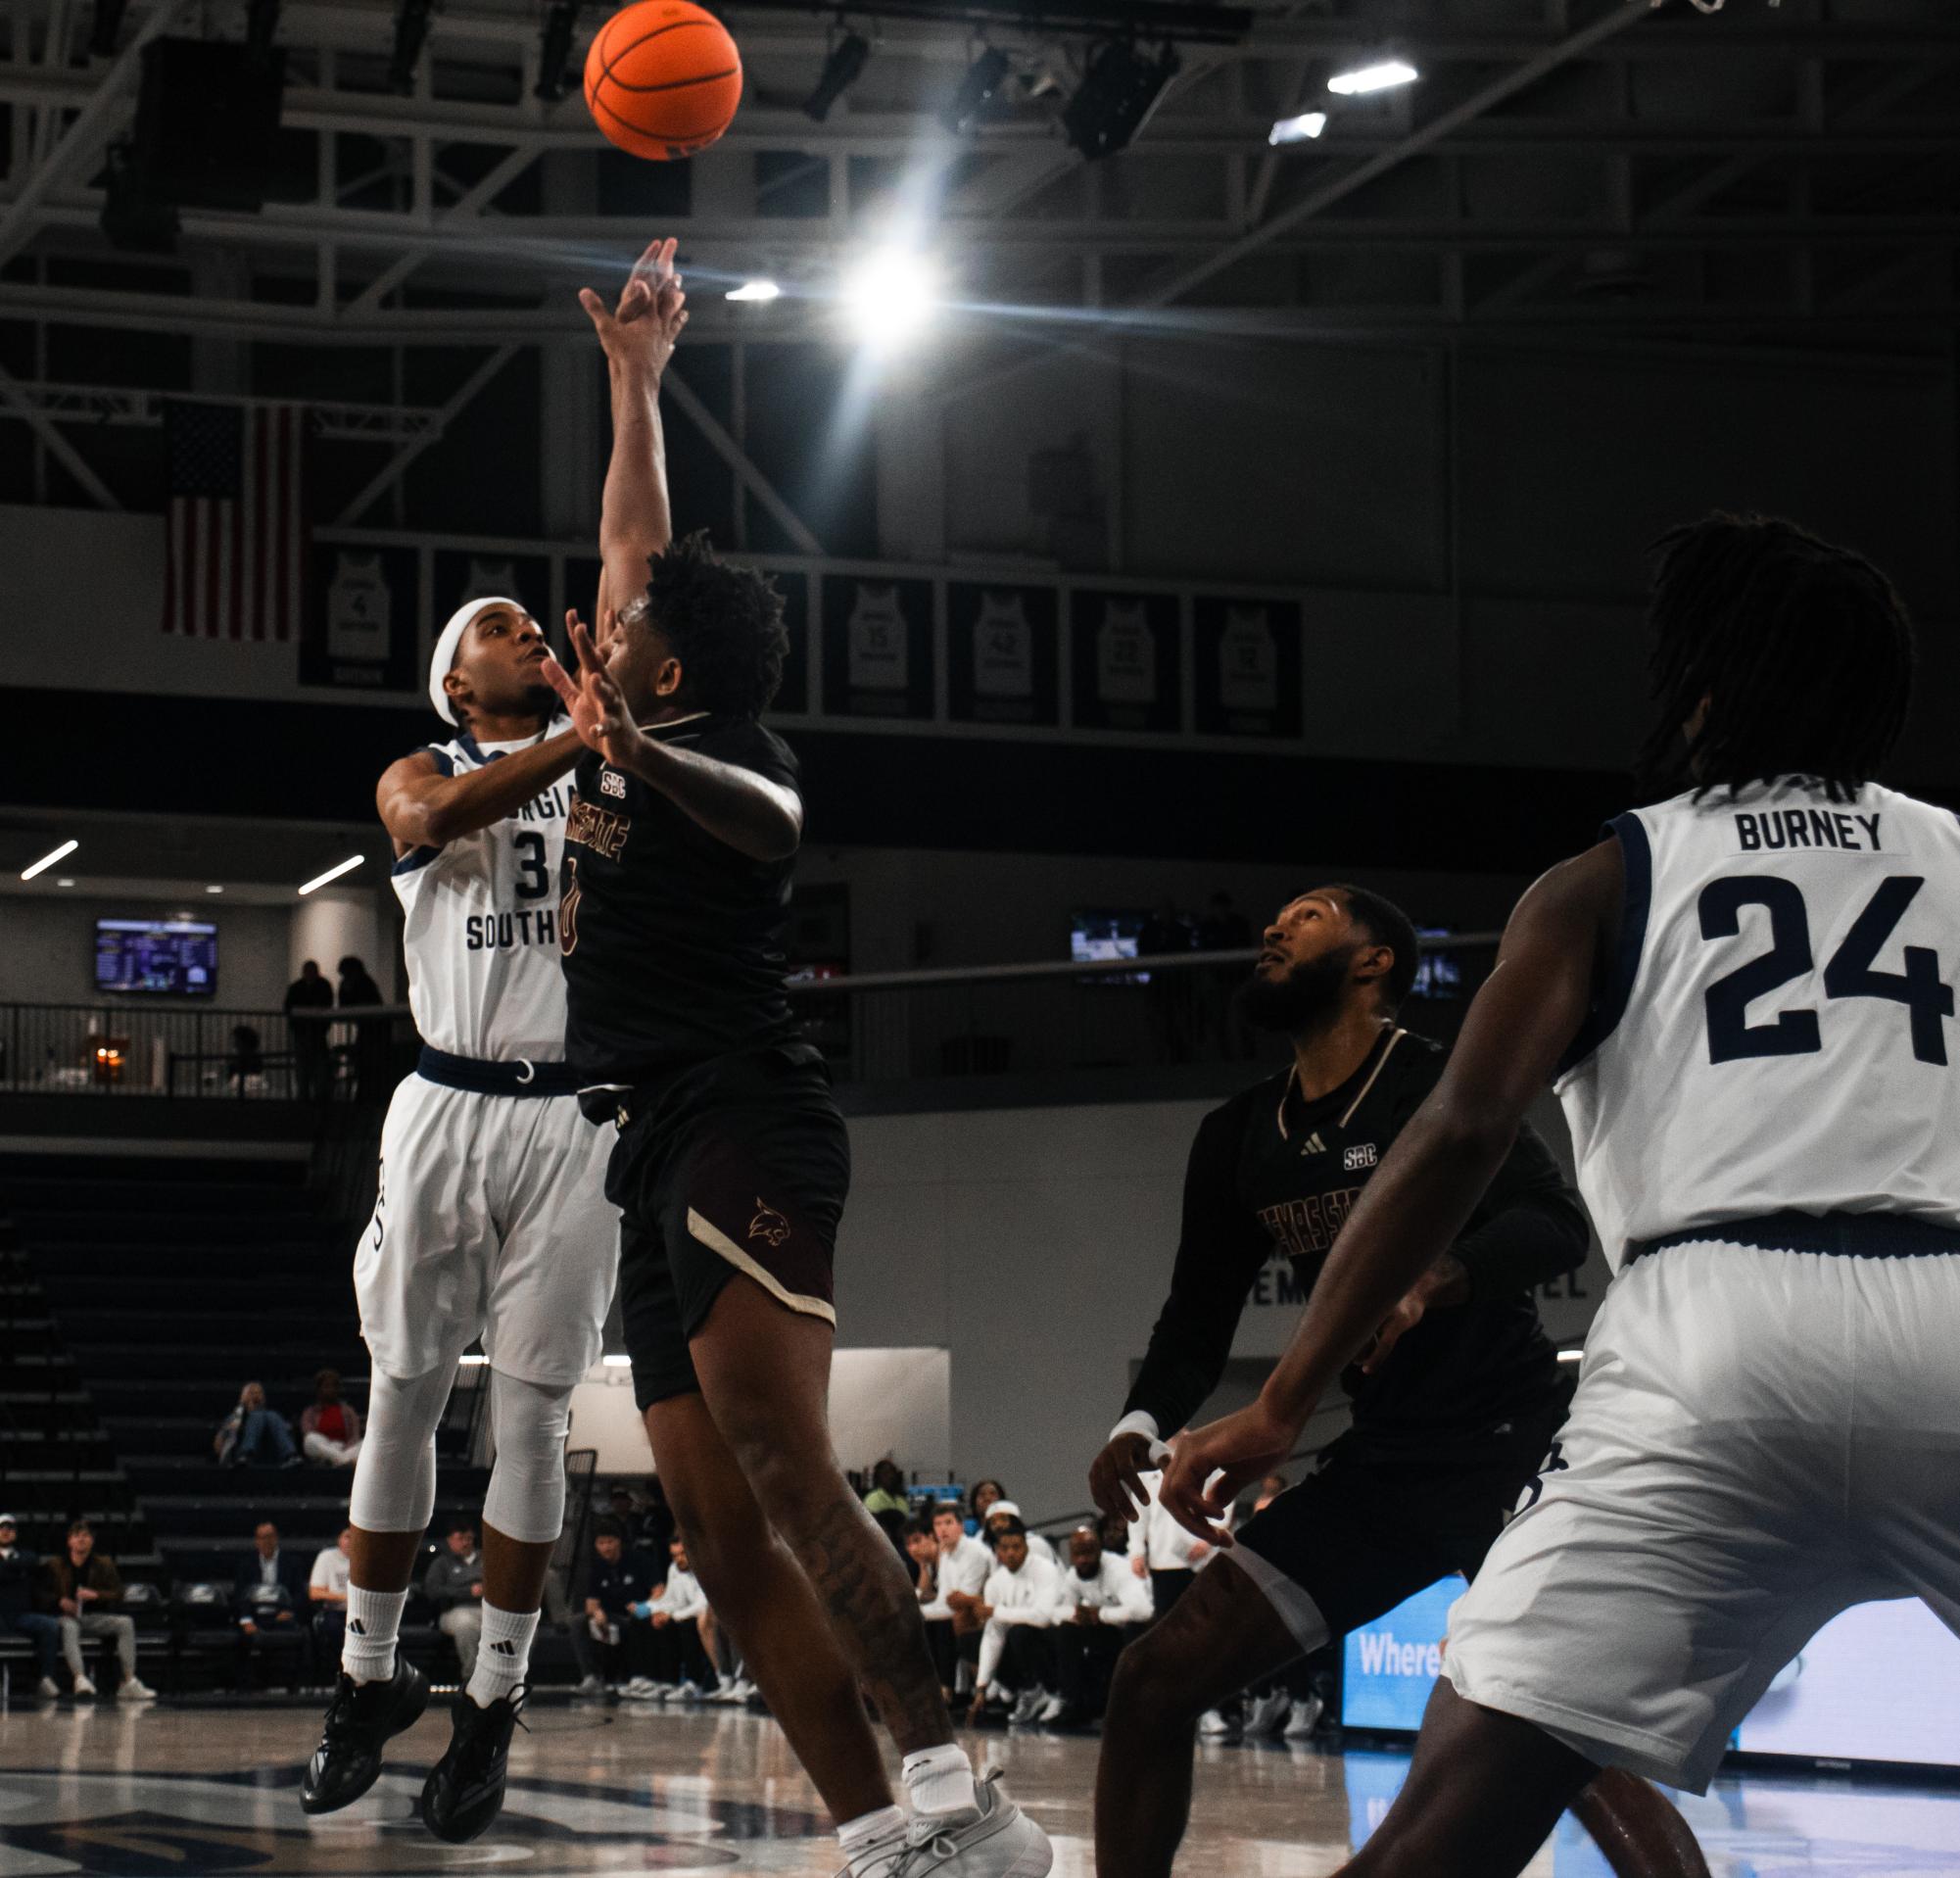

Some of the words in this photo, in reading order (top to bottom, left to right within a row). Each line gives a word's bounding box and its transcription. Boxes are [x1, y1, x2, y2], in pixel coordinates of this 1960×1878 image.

[351, 595, 367, 617] 4
[600, 770, 627, 799] SBC
[1735, 809, 1882, 851] BURNEY
[514, 832, 550, 899] 3
[1697, 875, 1955, 1067] 24
[1343, 1141, 1379, 1172] SBC
